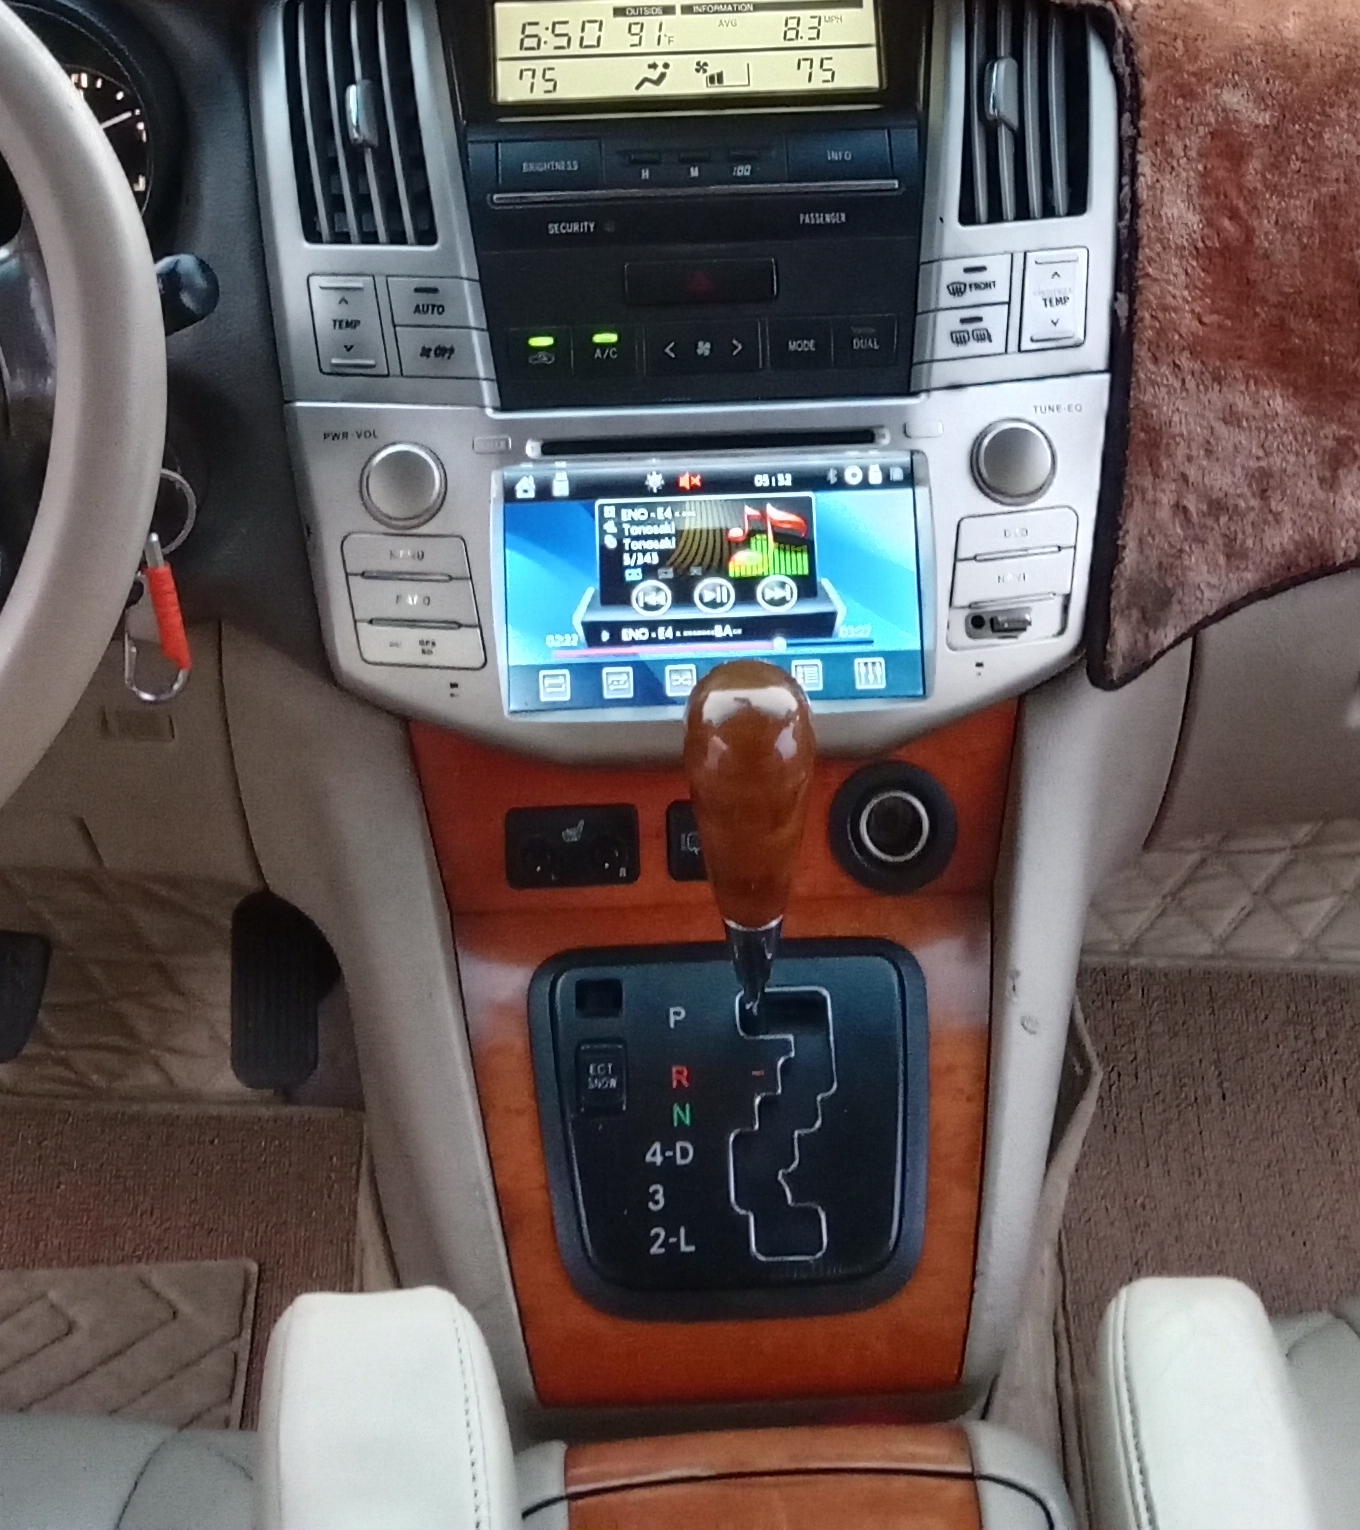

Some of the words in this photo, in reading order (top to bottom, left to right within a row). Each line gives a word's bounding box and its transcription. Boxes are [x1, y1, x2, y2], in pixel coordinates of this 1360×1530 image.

[625, 6, 663, 16] OUTSIDE
[693, 2, 753, 14] INFORMATION
[717, 18, 738, 29] AVG
[782, 15, 822, 42] 8.3
[519, 19, 604, 52] 6:50
[627, 21, 664, 48] 91
[796, 56, 837, 84] 75
[518, 67, 559, 94] 75
[799, 212, 846, 225] PASSENGER
[547, 221, 595, 234] SECURITY
[969, 281, 997, 292] FRONT
[1042, 296, 1070, 308] TEMP
[413, 304, 445, 315] AUTO
[332, 320, 361, 330] TEMP
[788, 339, 816, 352] MODE
[852, 337, 880, 350] DUAL
[594, 348, 618, 360] A/C
[669, 1006, 686, 1029] P
[671, 1065, 689, 1089] R
[672, 1102, 690, 1127] N
[645, 1141, 694, 1166] 4-D
[647, 1184, 665, 1211] 3
[649, 1226, 695, 1255] 2-L
